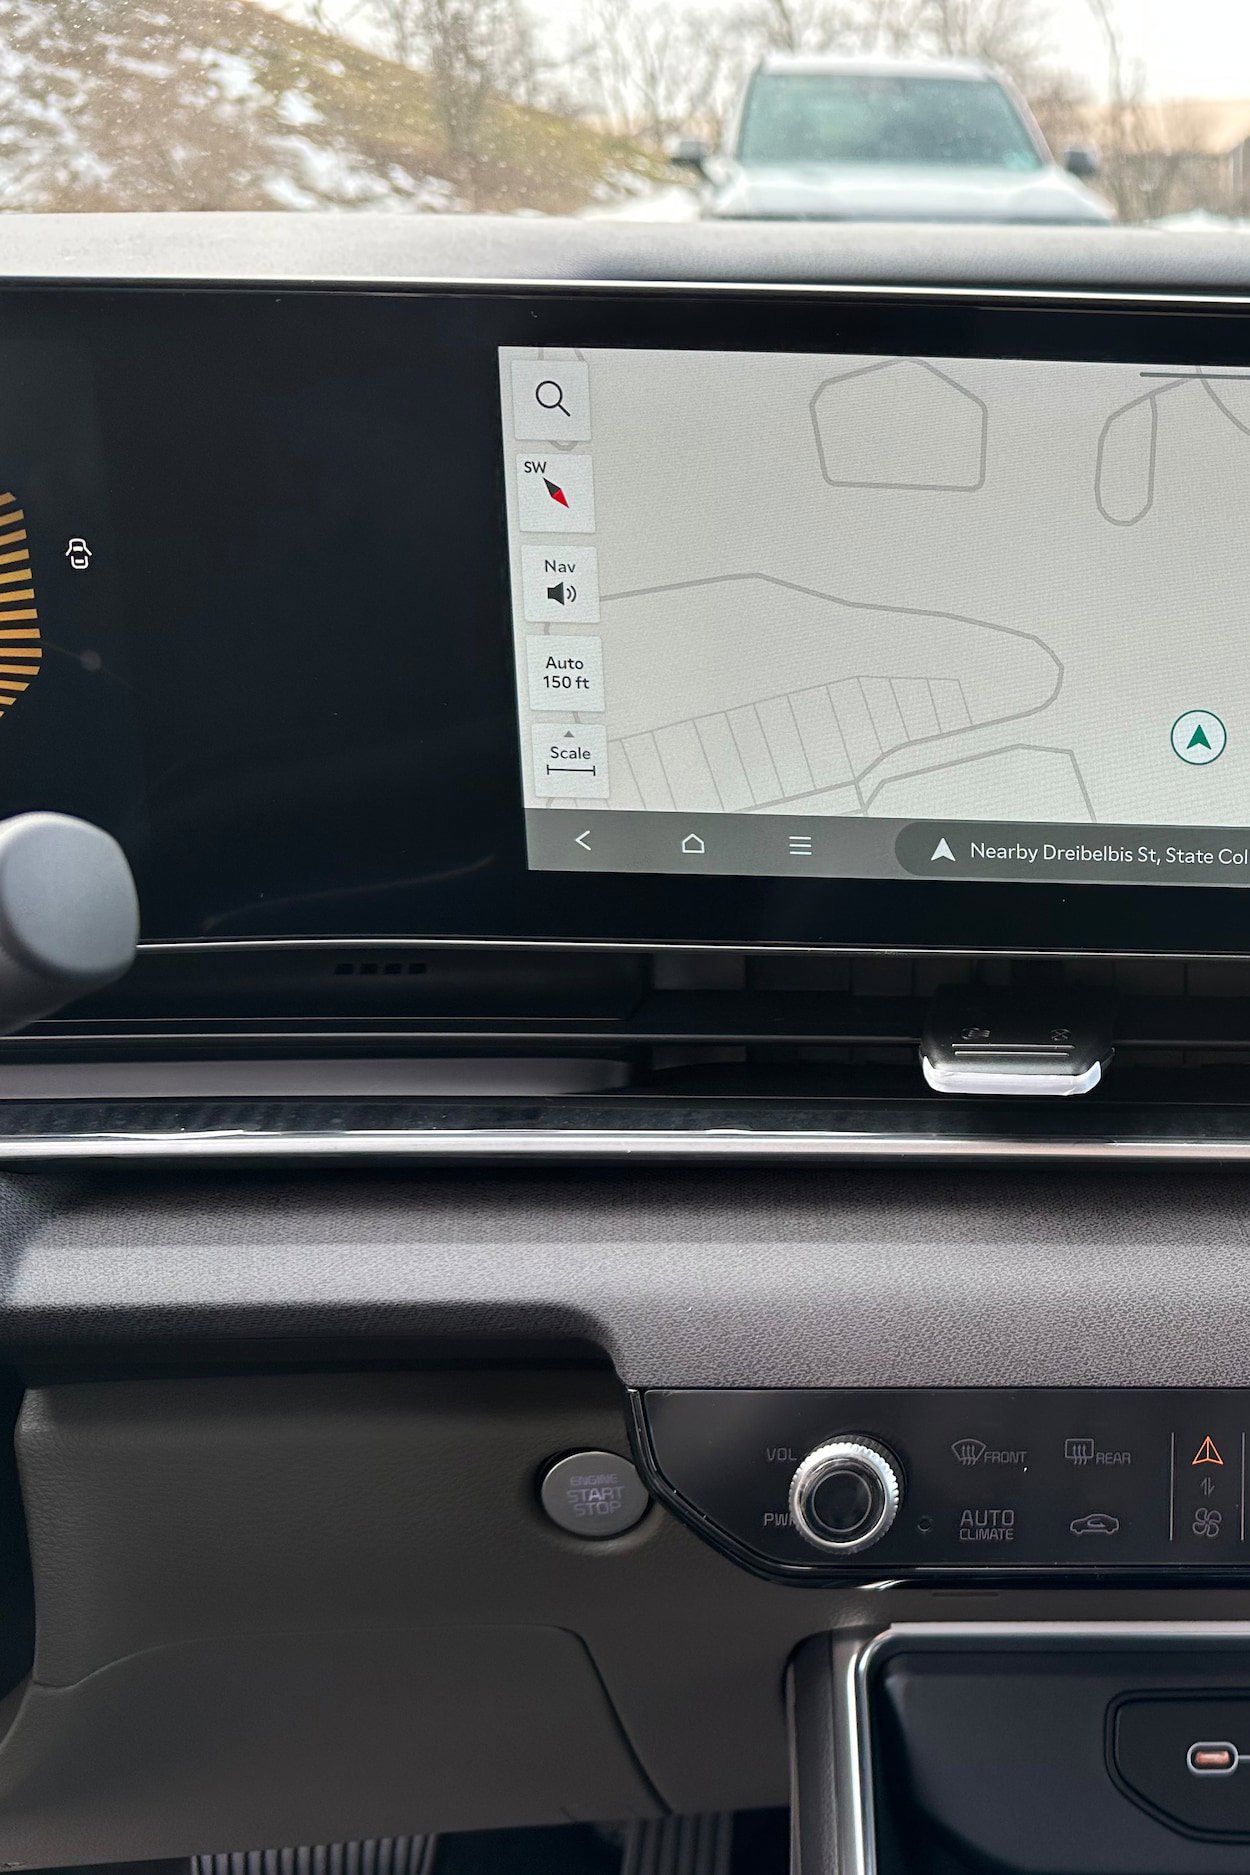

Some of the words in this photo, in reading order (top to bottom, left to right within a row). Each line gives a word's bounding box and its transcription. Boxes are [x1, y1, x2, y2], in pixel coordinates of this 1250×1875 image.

[523, 461, 548, 474] SW
[544, 559, 576, 573] Nav
[545, 656, 585, 670] Auto
[543, 675, 572, 689] 150
[575, 675, 590, 689] ft
[550, 746, 591, 760] Scale
[970, 842, 1038, 863] Nearby
[1043, 844, 1134, 863] Dreibelbis
[1137, 847, 1161, 867] St,
[1165, 847, 1214, 865] State
[766, 1447, 798, 1461] VOL
[983, 1450, 1028, 1464] FRONT
[1095, 1452, 1132, 1465] REAR
[570, 1473, 619, 1486] ENGINE
[566, 1485, 625, 1503] START
[574, 1501, 622, 1516] STOP
[959, 1509, 1015, 1527] AUTO
[959, 1527, 1015, 1541] CLIMATE
